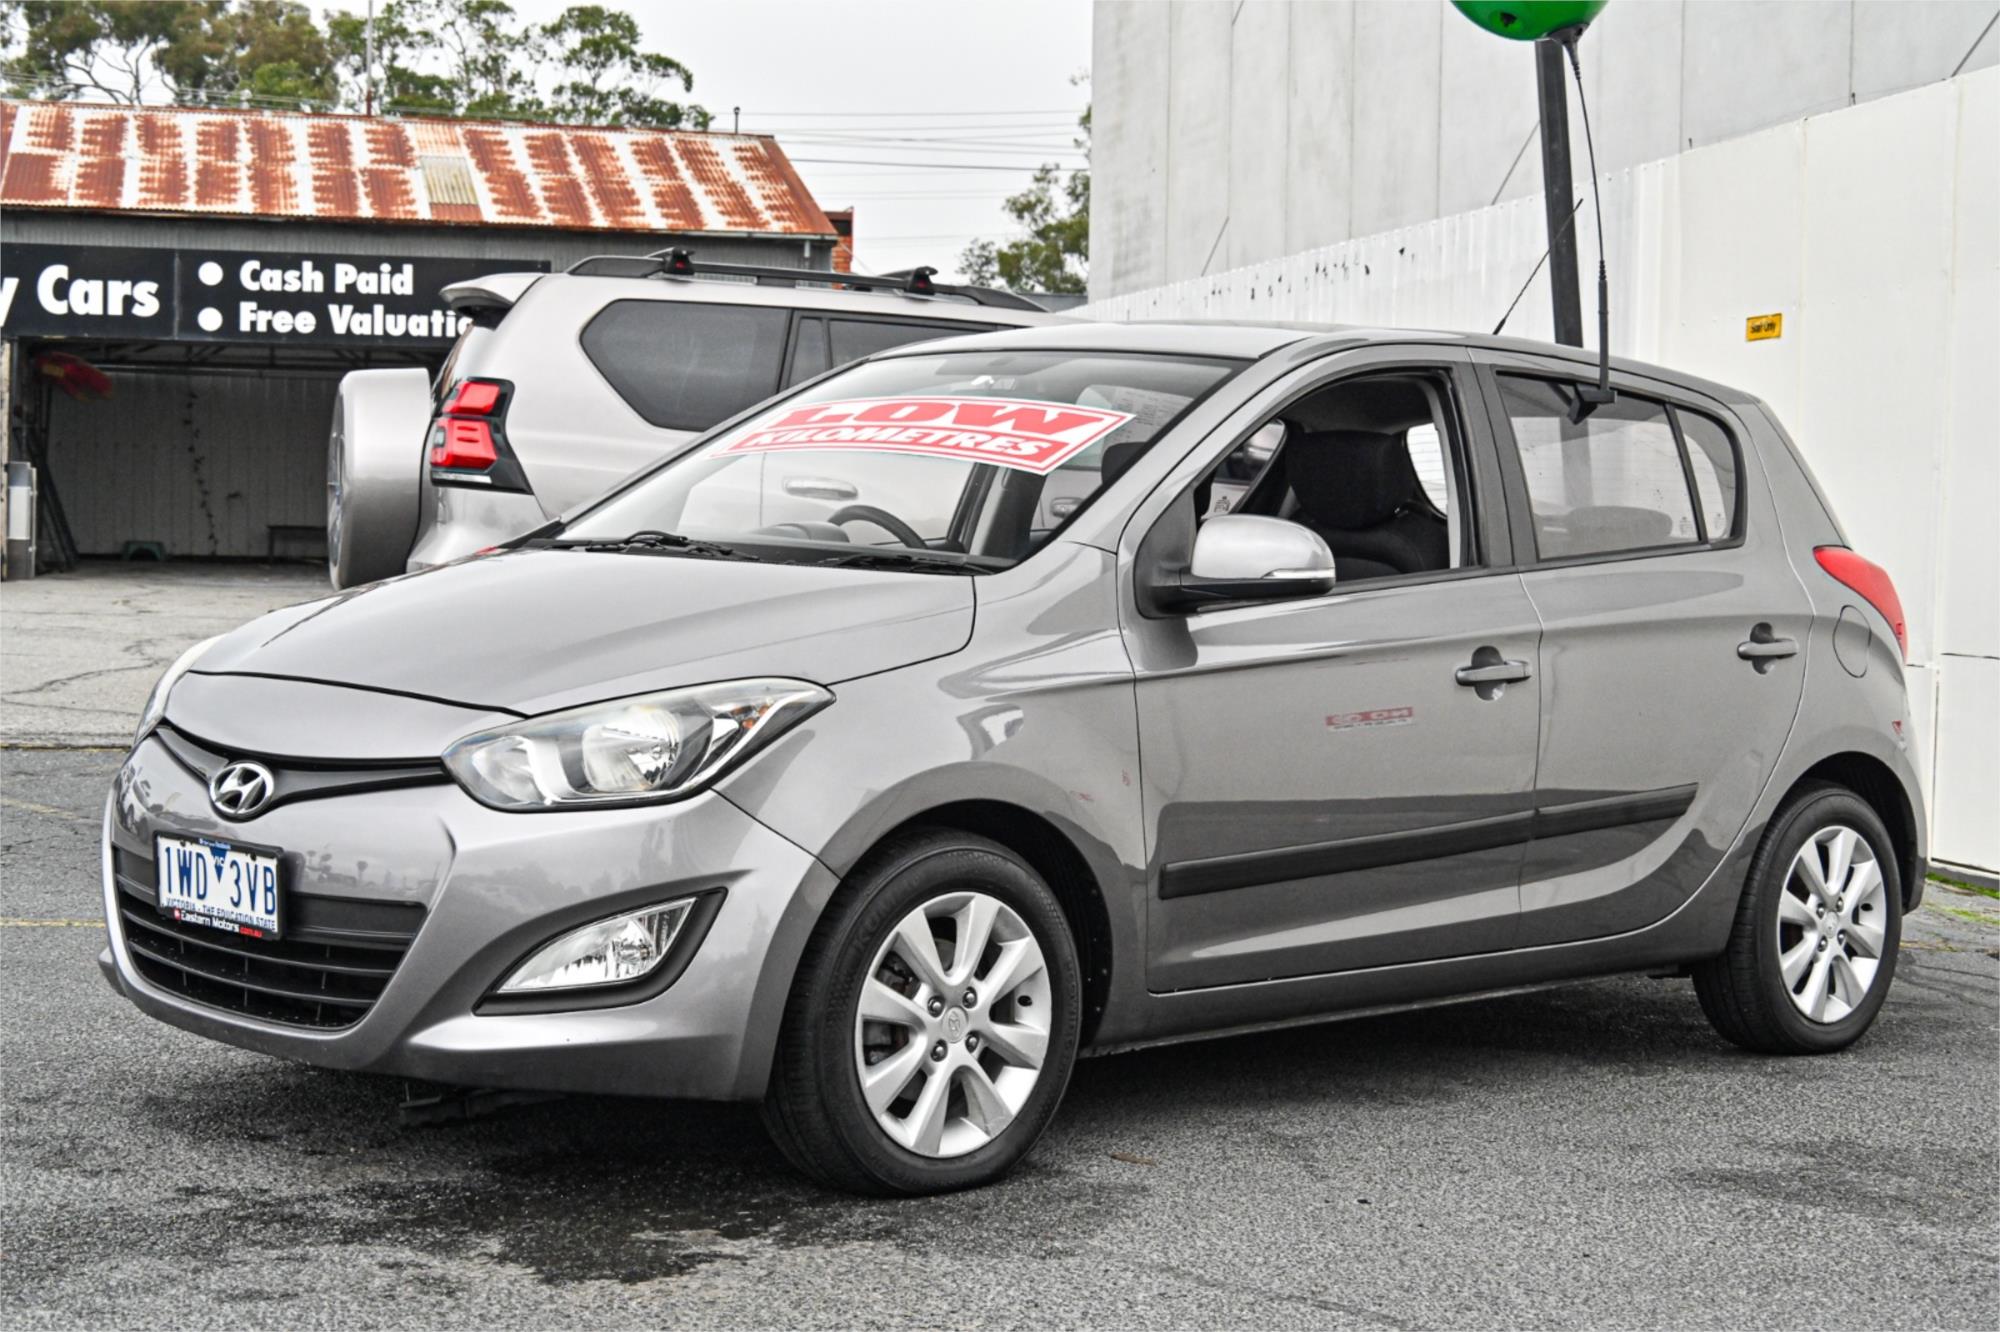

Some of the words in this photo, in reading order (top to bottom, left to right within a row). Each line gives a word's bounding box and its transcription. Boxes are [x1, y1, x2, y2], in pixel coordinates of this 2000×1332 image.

[37, 264, 160, 317] Cars
[239, 260, 324, 293] Cash
[335, 262, 414, 295] Paid
[239, 301, 317, 334] Free
[767, 402, 1104, 435] LOW
[745, 426, 1052, 456] KILOMETRES
[165, 846, 208, 900] 1WD
[230, 859, 276, 915] 3VB
